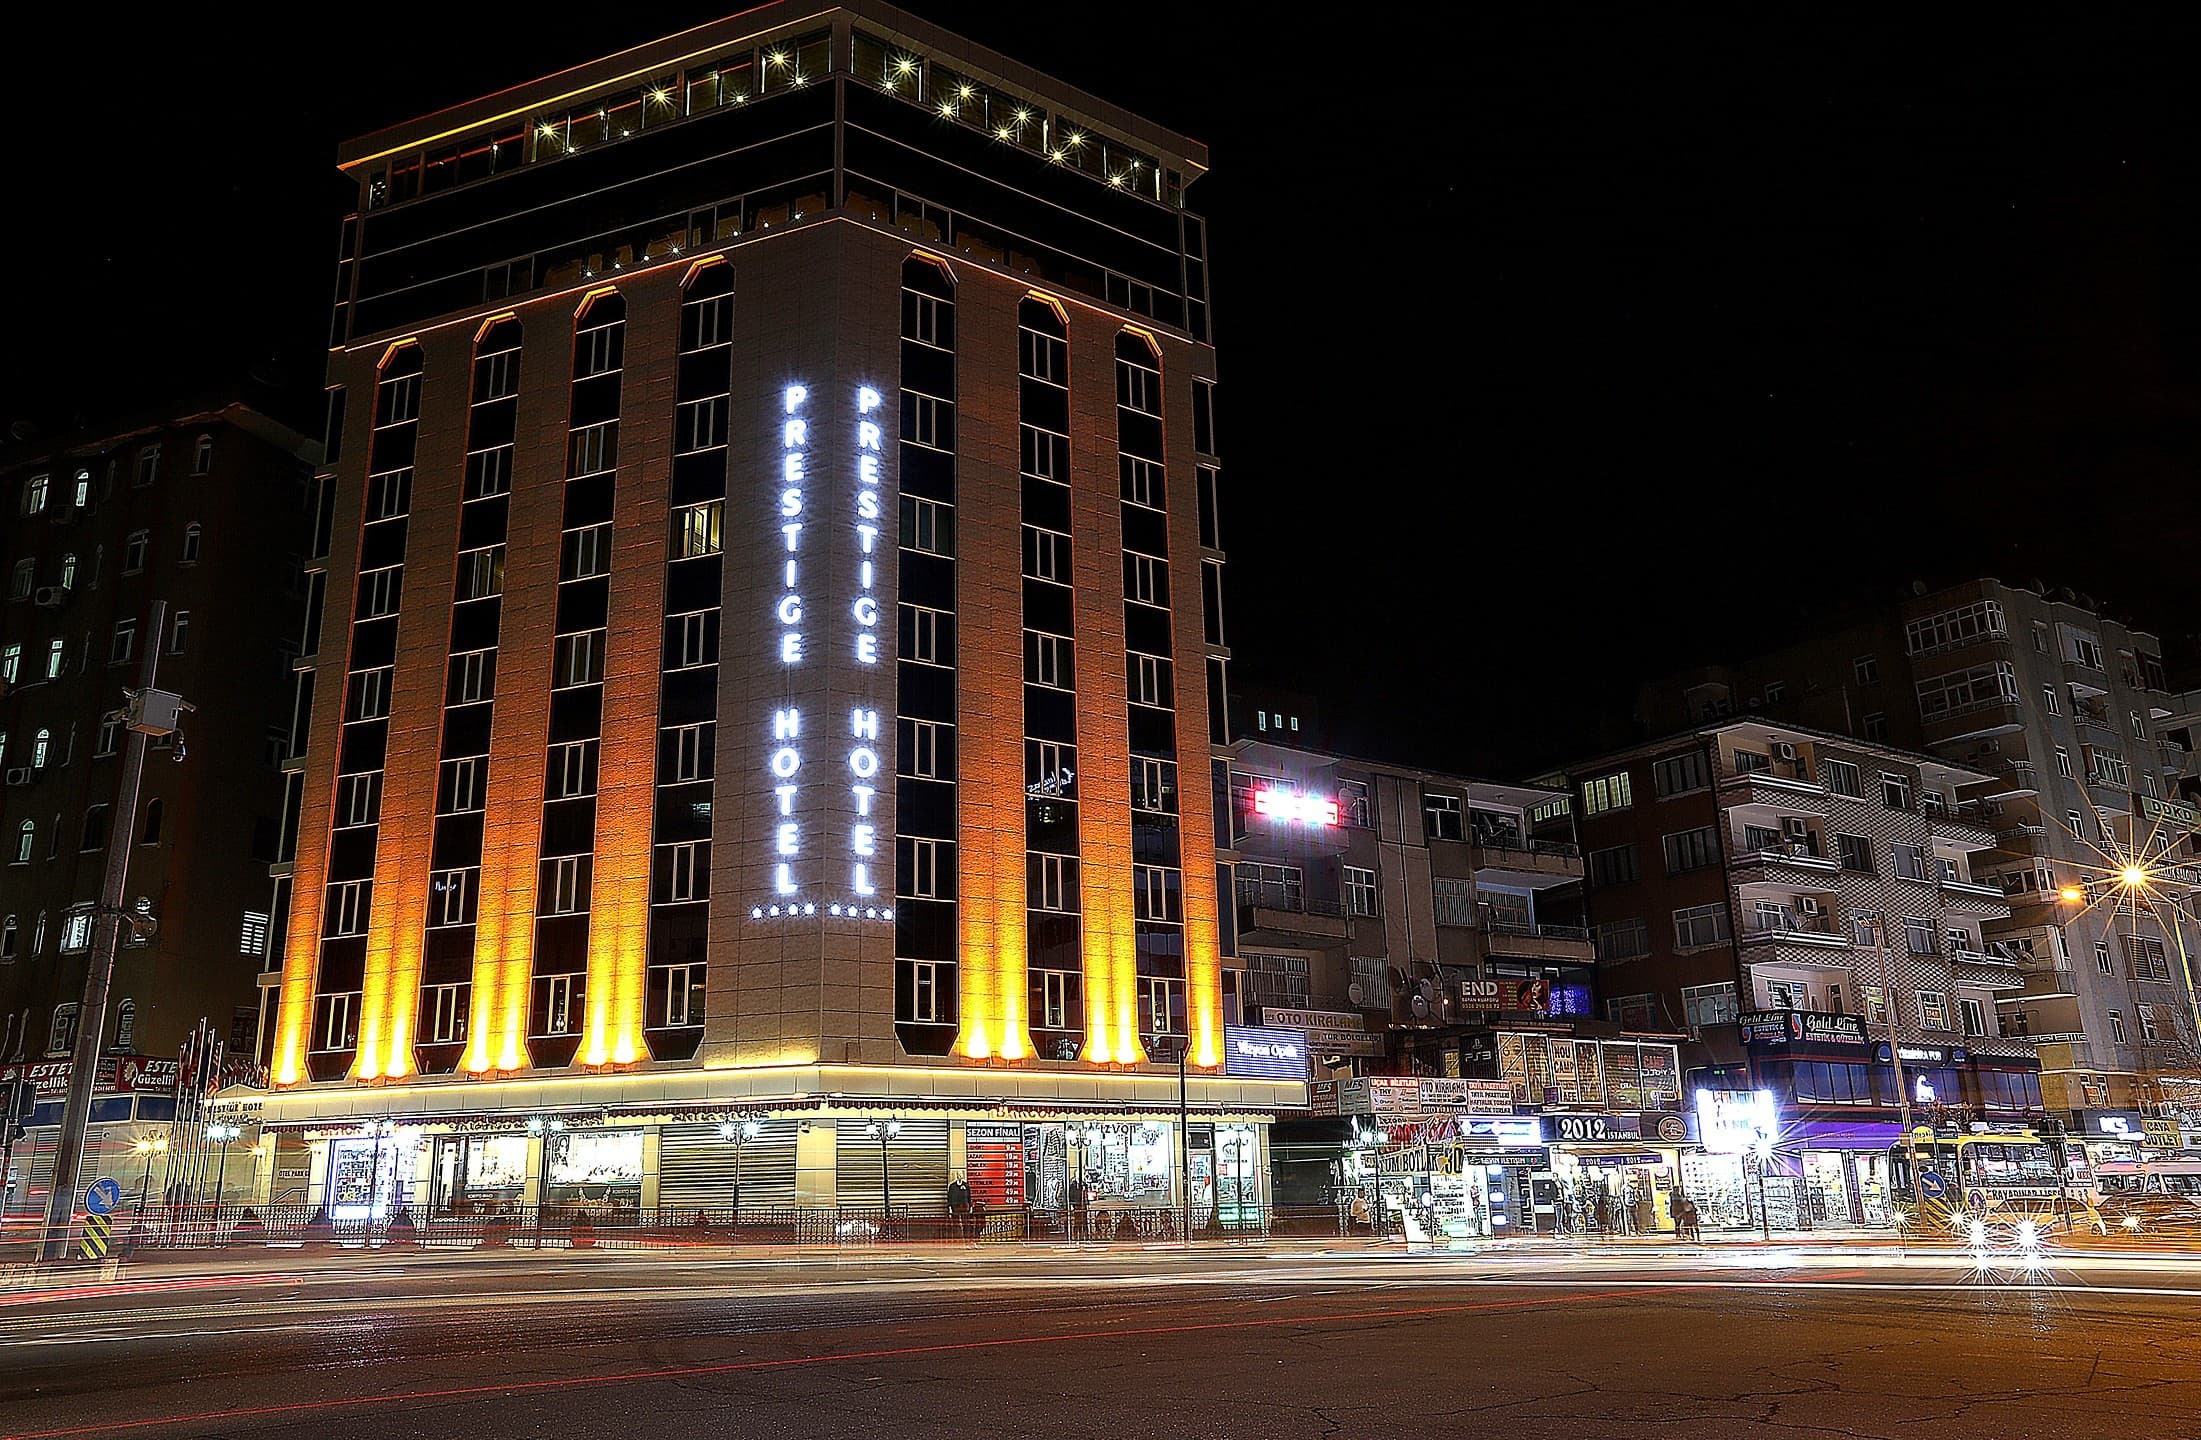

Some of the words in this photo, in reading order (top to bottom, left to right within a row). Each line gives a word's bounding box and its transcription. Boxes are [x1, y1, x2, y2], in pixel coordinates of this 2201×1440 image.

[778, 385, 807, 663] PRESTIGE
[853, 386, 881, 664] PRESTIGE
[772, 708, 801, 895] HOTEL
[849, 708, 878, 895] HOTEL
[2152, 800, 2193, 821] DDKD
[1461, 981, 1498, 996] END
[1276, 1012, 1301, 1025] OTO
[1305, 1014, 1363, 1030] KİRALAMA
[1806, 1014, 1833, 1031] Gold
[1835, 1017, 1860, 1031] Line
[1465, 1051, 1491, 1062] PS3
[1554, 1045, 1571, 1058] NOU
[1554, 1060, 1575, 1073] CAMP
[967, 1127, 994, 1137] SEZON
[1561, 1117, 1605, 1139] 2012
